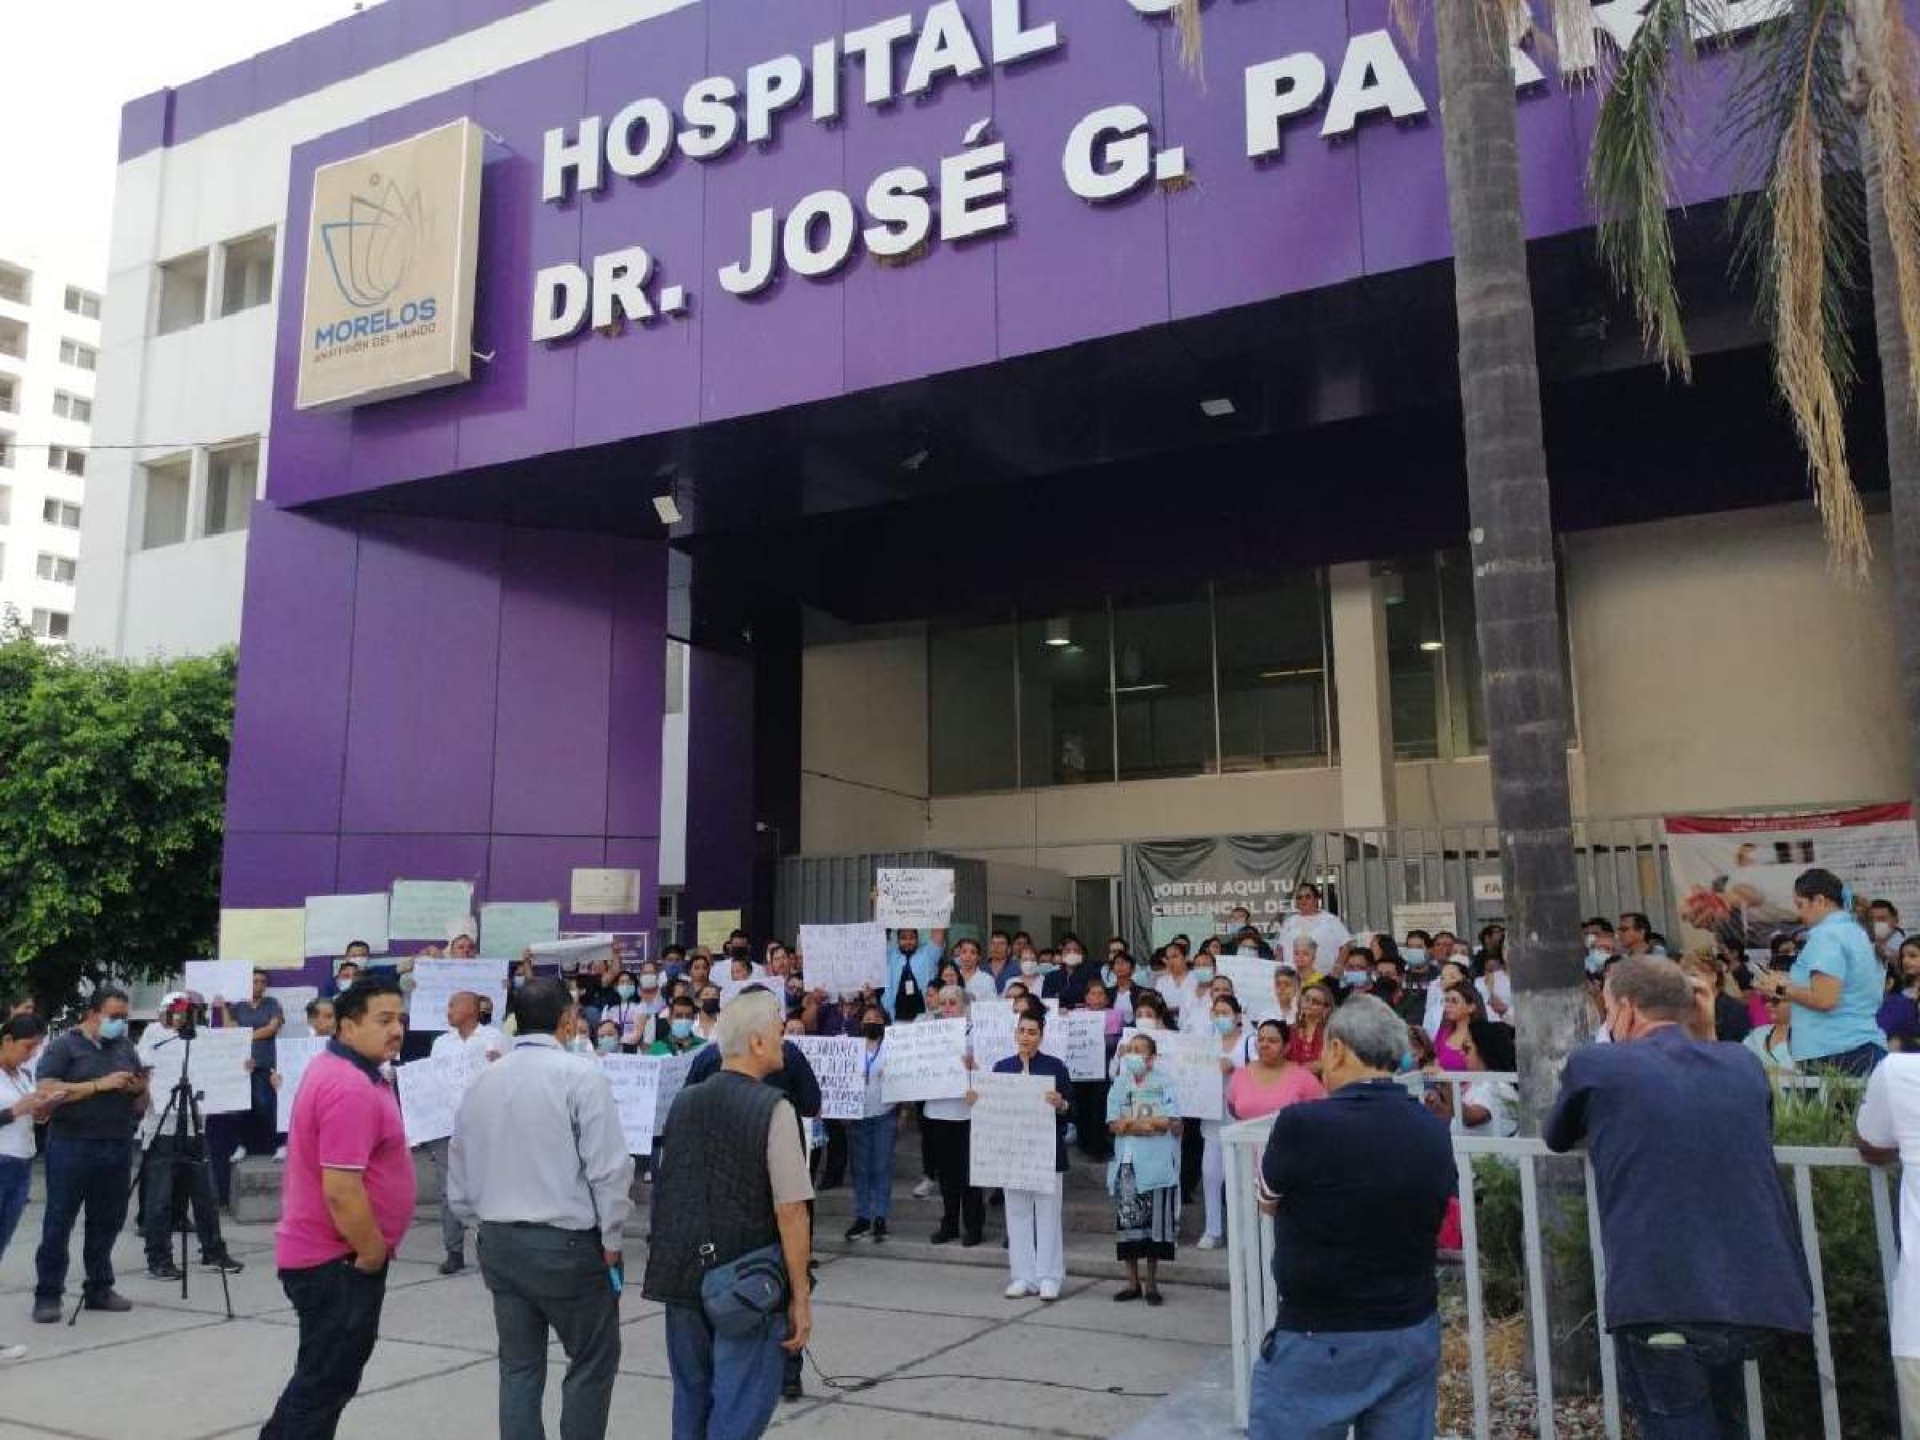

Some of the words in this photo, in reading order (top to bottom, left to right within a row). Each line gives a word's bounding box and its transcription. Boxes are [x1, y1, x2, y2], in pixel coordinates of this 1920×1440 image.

[542, 0, 1060, 205] HOSPITAL
[532, 246, 684, 343] DR.
[717, 117, 1010, 297] JOSÉ
[1062, 104, 1185, 200] G.
[314, 298, 436, 350] MORELOS
[1220, 876, 1267, 897] AQUÍ
[1271, 879, 1295, 893] TU
